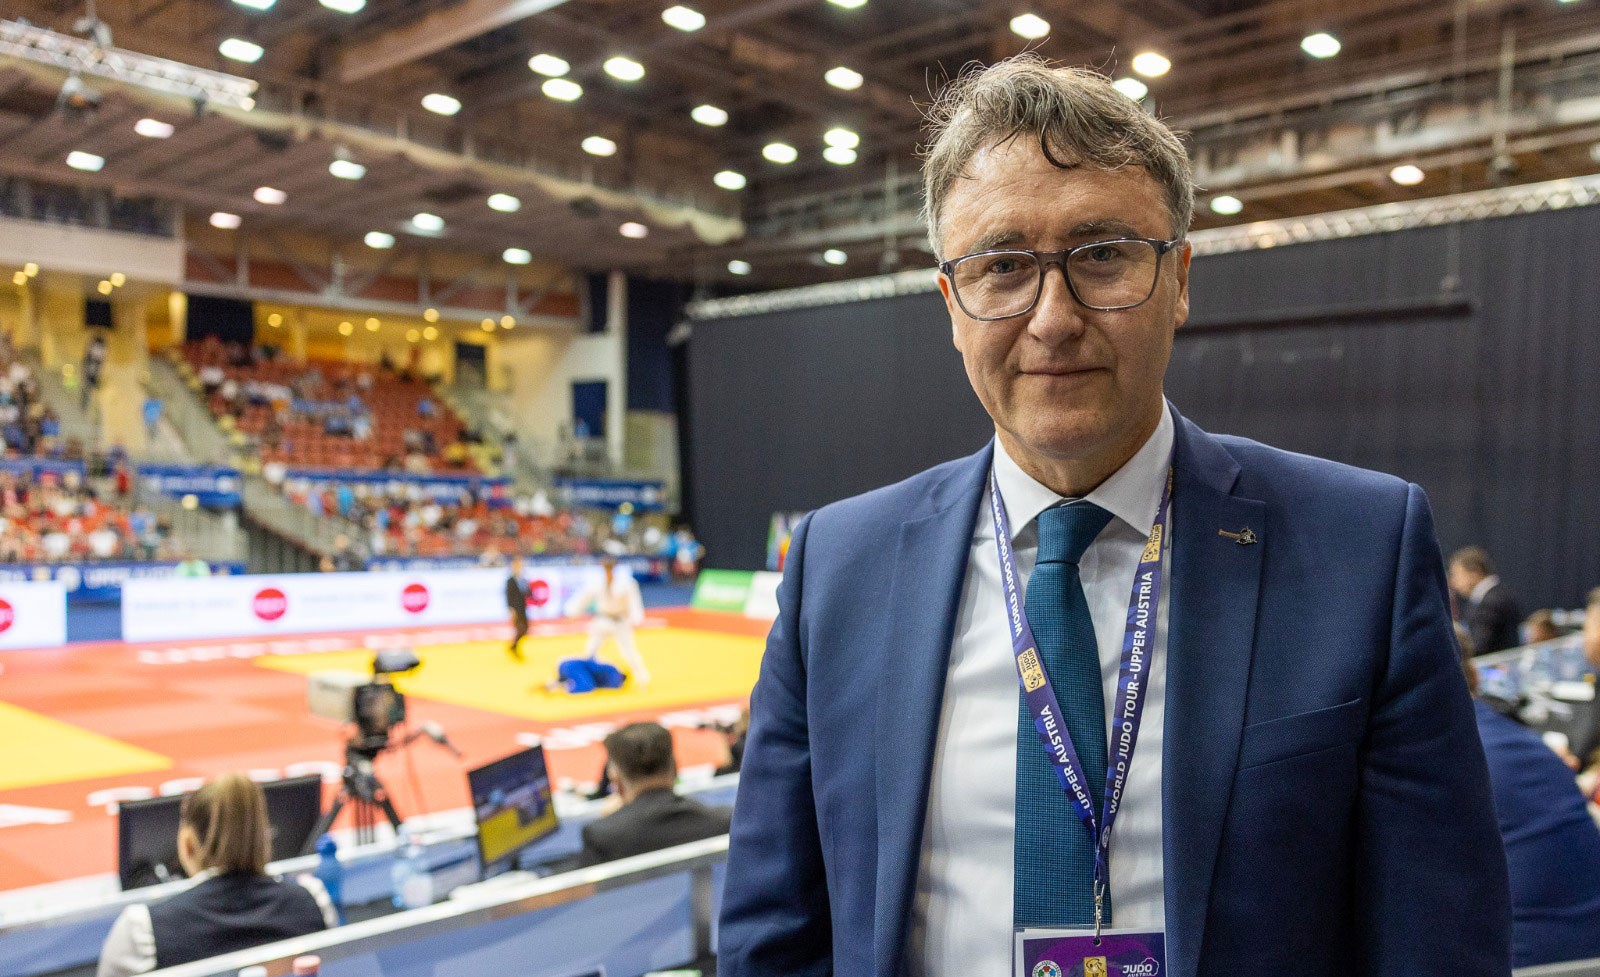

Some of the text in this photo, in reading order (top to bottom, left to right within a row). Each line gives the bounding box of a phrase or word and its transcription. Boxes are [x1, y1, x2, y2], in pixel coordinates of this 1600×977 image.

[998, 529, 1009, 560] TOUR
[1003, 561, 1015, 592] JUDO
[1009, 591, 1023, 637] WORLD
[1135, 571, 1153, 628] AUSTRIA
[1028, 649, 1037, 668] TOUR
[1129, 630, 1146, 672] UPPER
[1123, 681, 1139, 718] TOUR
[1040, 704, 1070, 763] AUSTRIA
[1118, 721, 1132, 759] JUDO
[1063, 764, 1090, 809] UPPER
[1109, 761, 1125, 813] WORLD
[1122, 964, 1153, 974] JUDO
